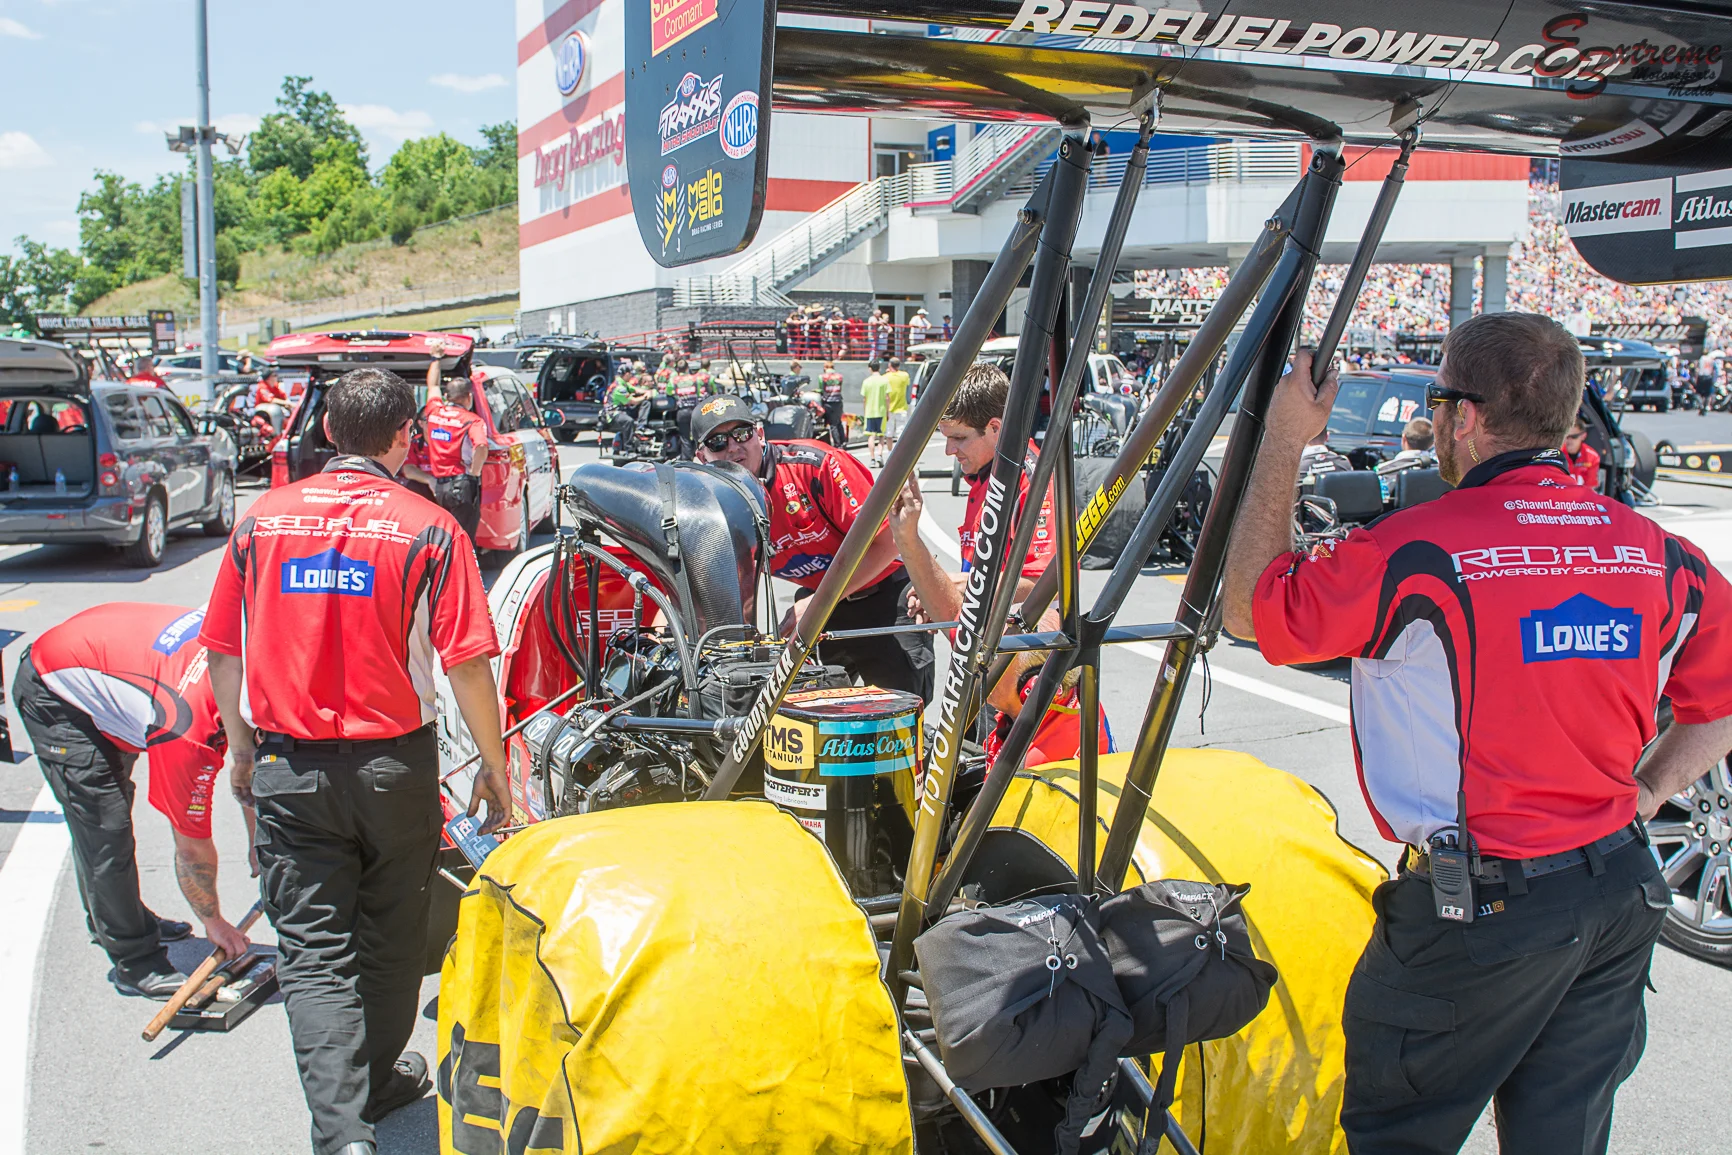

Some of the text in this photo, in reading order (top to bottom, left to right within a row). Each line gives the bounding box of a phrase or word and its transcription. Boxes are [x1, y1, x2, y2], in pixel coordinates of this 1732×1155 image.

[664, 1, 703, 39] Coromant
[661, 80, 721, 139] TRAXXAS
[726, 103, 758, 148] NHRA
[534, 112, 625, 192] Drag Racing
[1564, 197, 1663, 225] Mastercam
[1150, 299, 1219, 314] MATC
[124, 316, 149, 328] SALES
[1602, 324, 1691, 341] LUCAS OIL
[1503, 499, 1596, 513] @ShawnLangdonTF
[1516, 513, 1602, 526] @BatteryChargrs
[251, 529, 411, 546] POWERED BY SCHUMACHER
[1562, 546, 1663, 568] FUEL
[290, 565, 366, 592] LOWE'S
[1457, 566, 1664, 584] POWERED BY SCHUMACHER
[920, 474, 1007, 817] TOYOTARACING.COM
[1535, 620, 1629, 654] LOWE'S
[732, 649, 796, 764] GOODYEAR
[819, 736, 916, 757] Atlas Copco
[766, 778, 821, 798] GSTERFER'S
[800, 820, 822, 829] AMAHA
[1180, 892, 1214, 902] IMPACT
[1030, 903, 1061, 923] IMPACT
[1444, 907, 1462, 917] R.E.
[1478, 903, 1494, 917] .11
